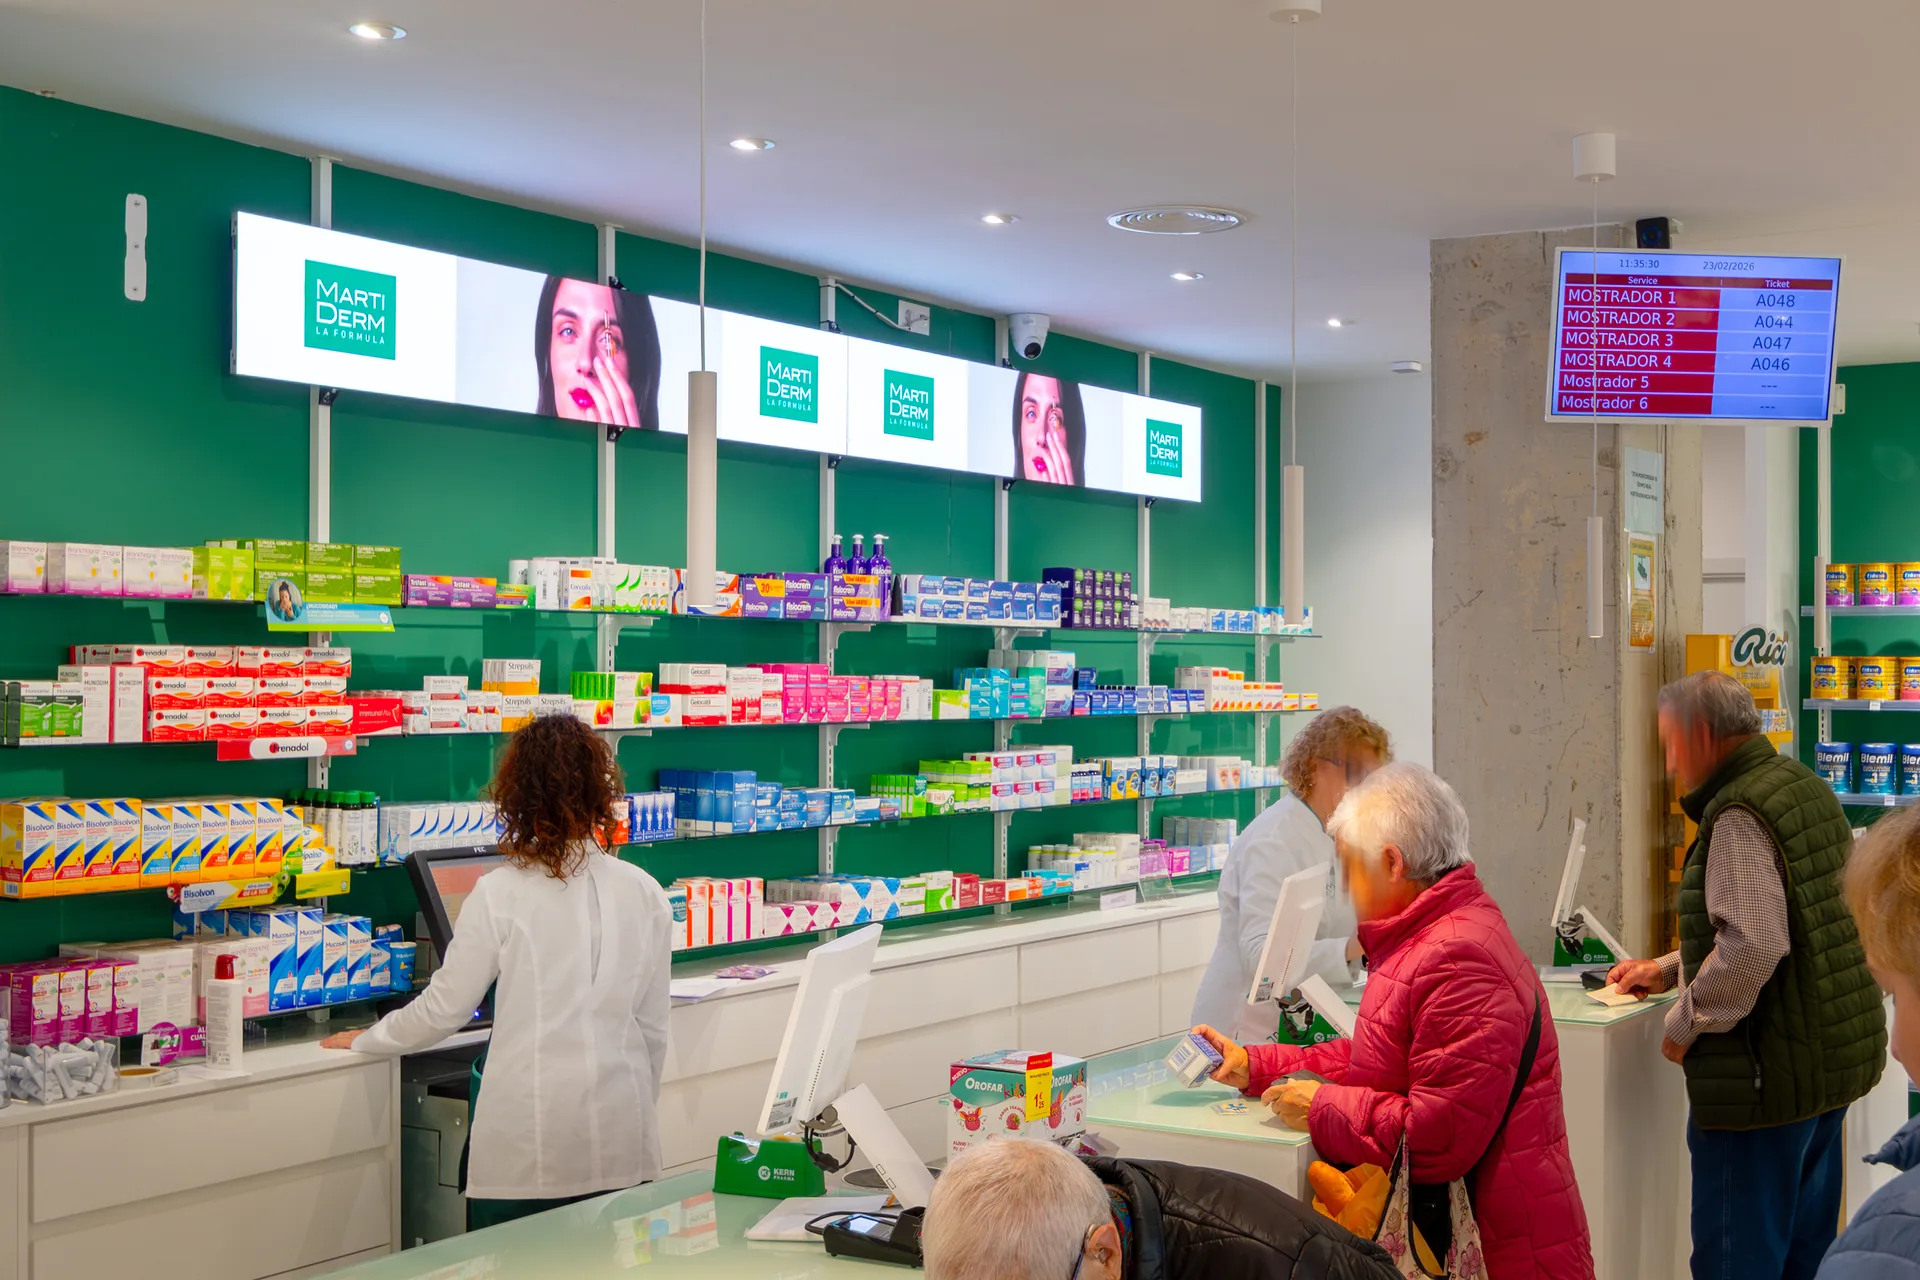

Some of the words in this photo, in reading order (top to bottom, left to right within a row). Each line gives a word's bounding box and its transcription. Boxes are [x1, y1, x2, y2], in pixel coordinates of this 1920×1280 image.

[1619, 259, 1660, 268] 11:35:30
[1703, 261, 1755, 271] 23/02/2026
[1628, 276, 1658, 285] Service
[1765, 279, 1790, 289] Ticket
[316, 278, 385, 311] MARTI
[1568, 288, 1663, 304] MOSTRADOR
[1668, 291, 1676, 304] 1
[1756, 293, 1795, 308] A048
[316, 300, 385, 333] DERM
[1567, 310, 1661, 325] MOSTRADOR
[1666, 313, 1675, 325] 2
[1754, 315, 1793, 329] A044
[316, 326, 328, 336] LA
[334, 328, 385, 344] FORMULA
[1565, 332, 1659, 346] MOSTRADOR
[1665, 334, 1673, 346] 3
[1753, 336, 1791, 350] A047
[1564, 353, 1658, 368] MOSTRADOR
[1663, 355, 1672, 368] 4
[1751, 358, 1790, 371] A046
[767, 360, 812, 384] MARTI
[1563, 374, 1636, 388] Mostrador
[1641, 376, 1649, 388] 5
[767, 378, 812, 402] DERM
[889, 382, 929, 404] MARTI
[767, 398, 775, 406] LA
[778, 399, 811, 411] FORMULA
[1562, 395, 1635, 409] Mostrador
[1639, 397, 1648, 409] 6
[889, 399, 929, 421] DERM
[900, 419, 928, 429] FORMULA
[1150, 429, 1179, 447] MARTI
[1150, 443, 1179, 461] DERM
[508, 662, 534, 670] Strepsils
[505, 697, 532, 705] Strepsils
[540, 697, 566, 705] Strepsils
[1817, 752, 1850, 762] Blemil
[1861, 753, 1894, 764] Blemil
[25, 822, 55, 832] Bisolvon
[56, 821, 85, 830] Bisolvon
[86, 819, 113, 828] Bisolvon
[113, 818, 140, 827] Bisolvon
[173, 821, 200, 830] Bisolvon
[202, 818, 228, 828] Bisolvon
[230, 817, 256, 827] Bisolvon
[257, 816, 282, 825] Bisolvon
[143, 823, 171, 832] Bisolvon
[183, 888, 215, 899] Bisolvon
[951, 1067, 968, 1081] NUEVO
[1003, 1082, 1025, 1099] kids
[1034, 1094, 1038, 1107] 1
[773, 1168, 795, 1176] KERN
